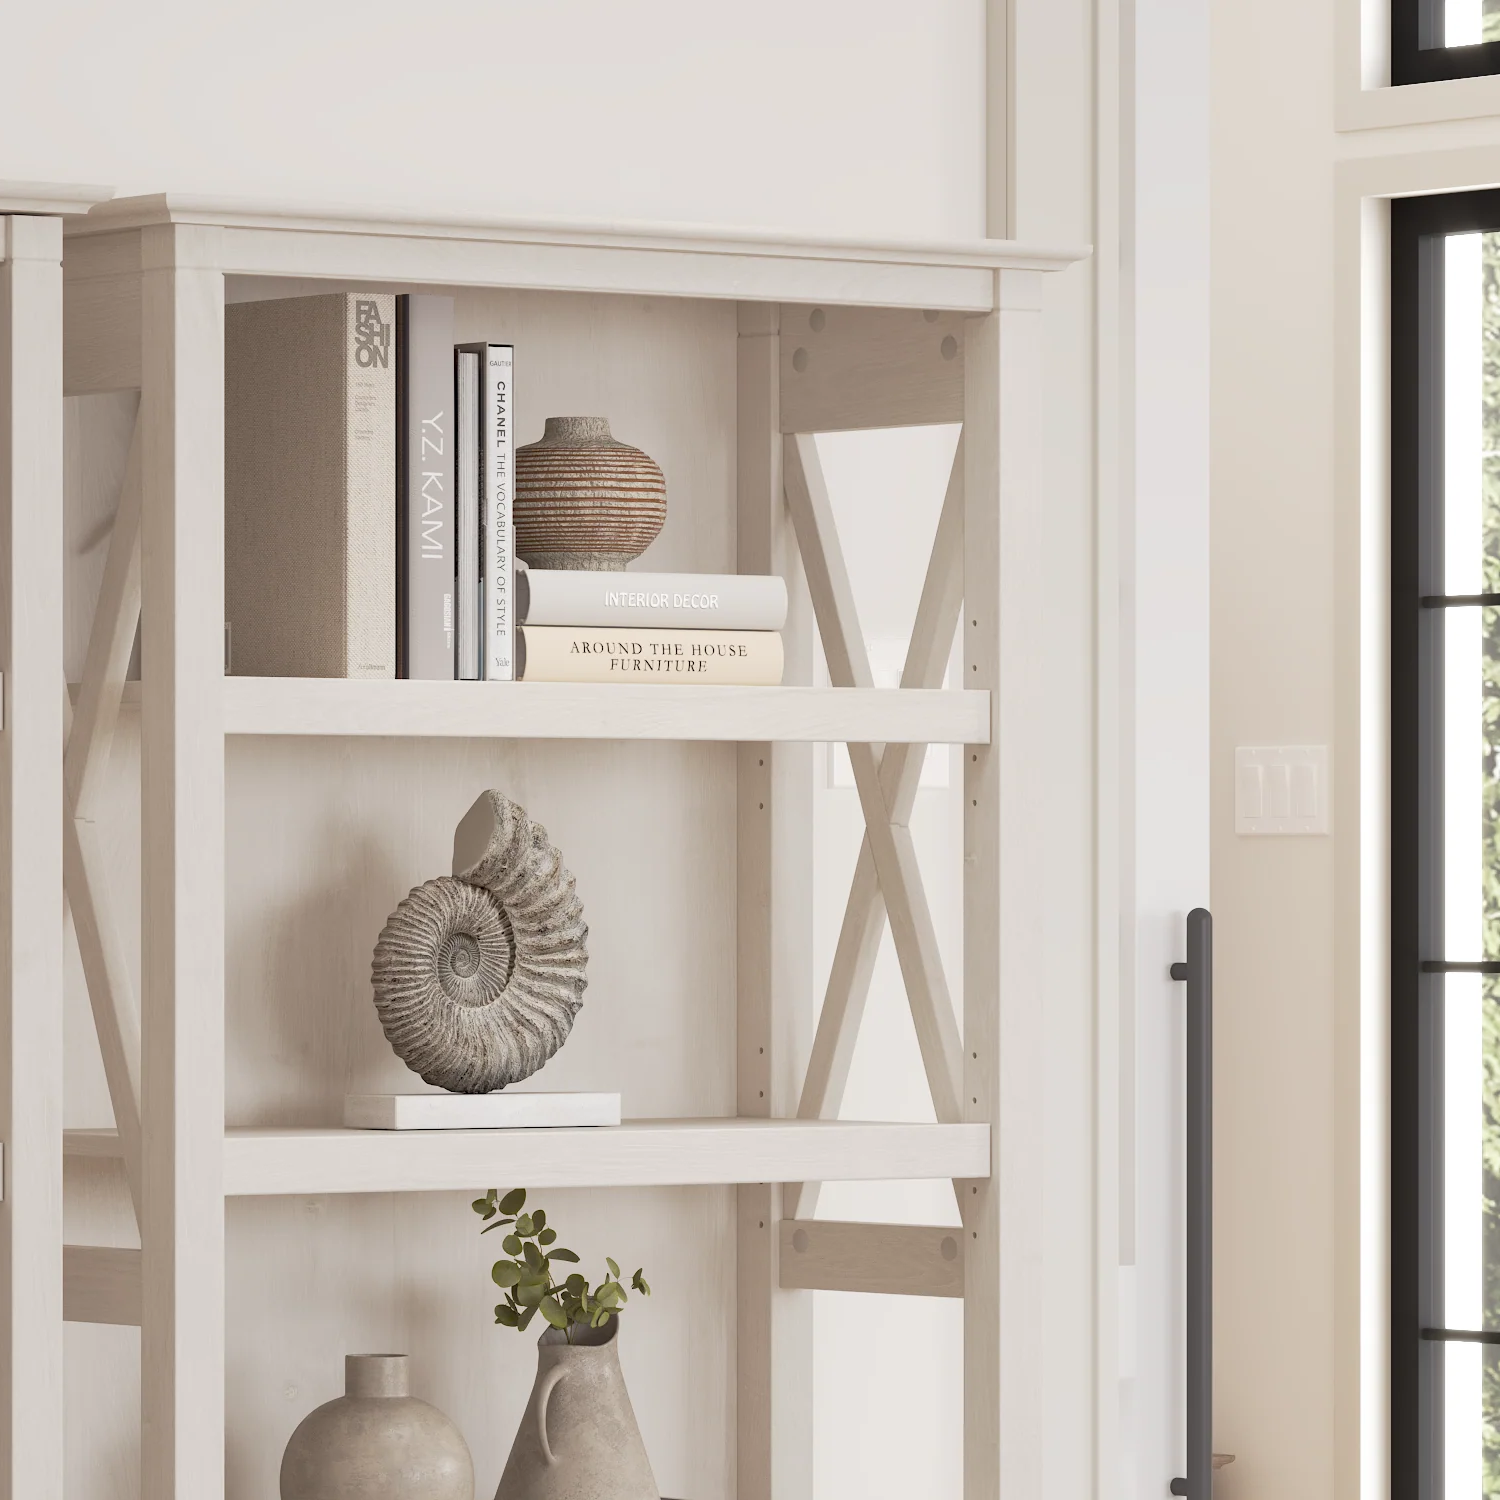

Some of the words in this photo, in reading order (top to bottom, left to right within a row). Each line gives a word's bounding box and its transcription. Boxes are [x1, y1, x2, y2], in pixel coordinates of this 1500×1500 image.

[496, 381, 506, 448] CHANEL
[421, 410, 444, 461] Y.Z.
[496, 453, 506, 477] THE
[421, 471, 444, 559] KAMI
[496, 482, 506, 572] VOCABULARY
[496, 576, 506, 594] OF
[604, 590, 669, 609] INTERIOR
[673, 593, 719, 610] DECOR
[496, 598, 506, 637] STYLE
[570, 641, 643, 656] AROUND
[650, 643, 684, 656] THE
[691, 644, 748, 657] HOUSE
[609, 658, 708, 673] FURNITURE
